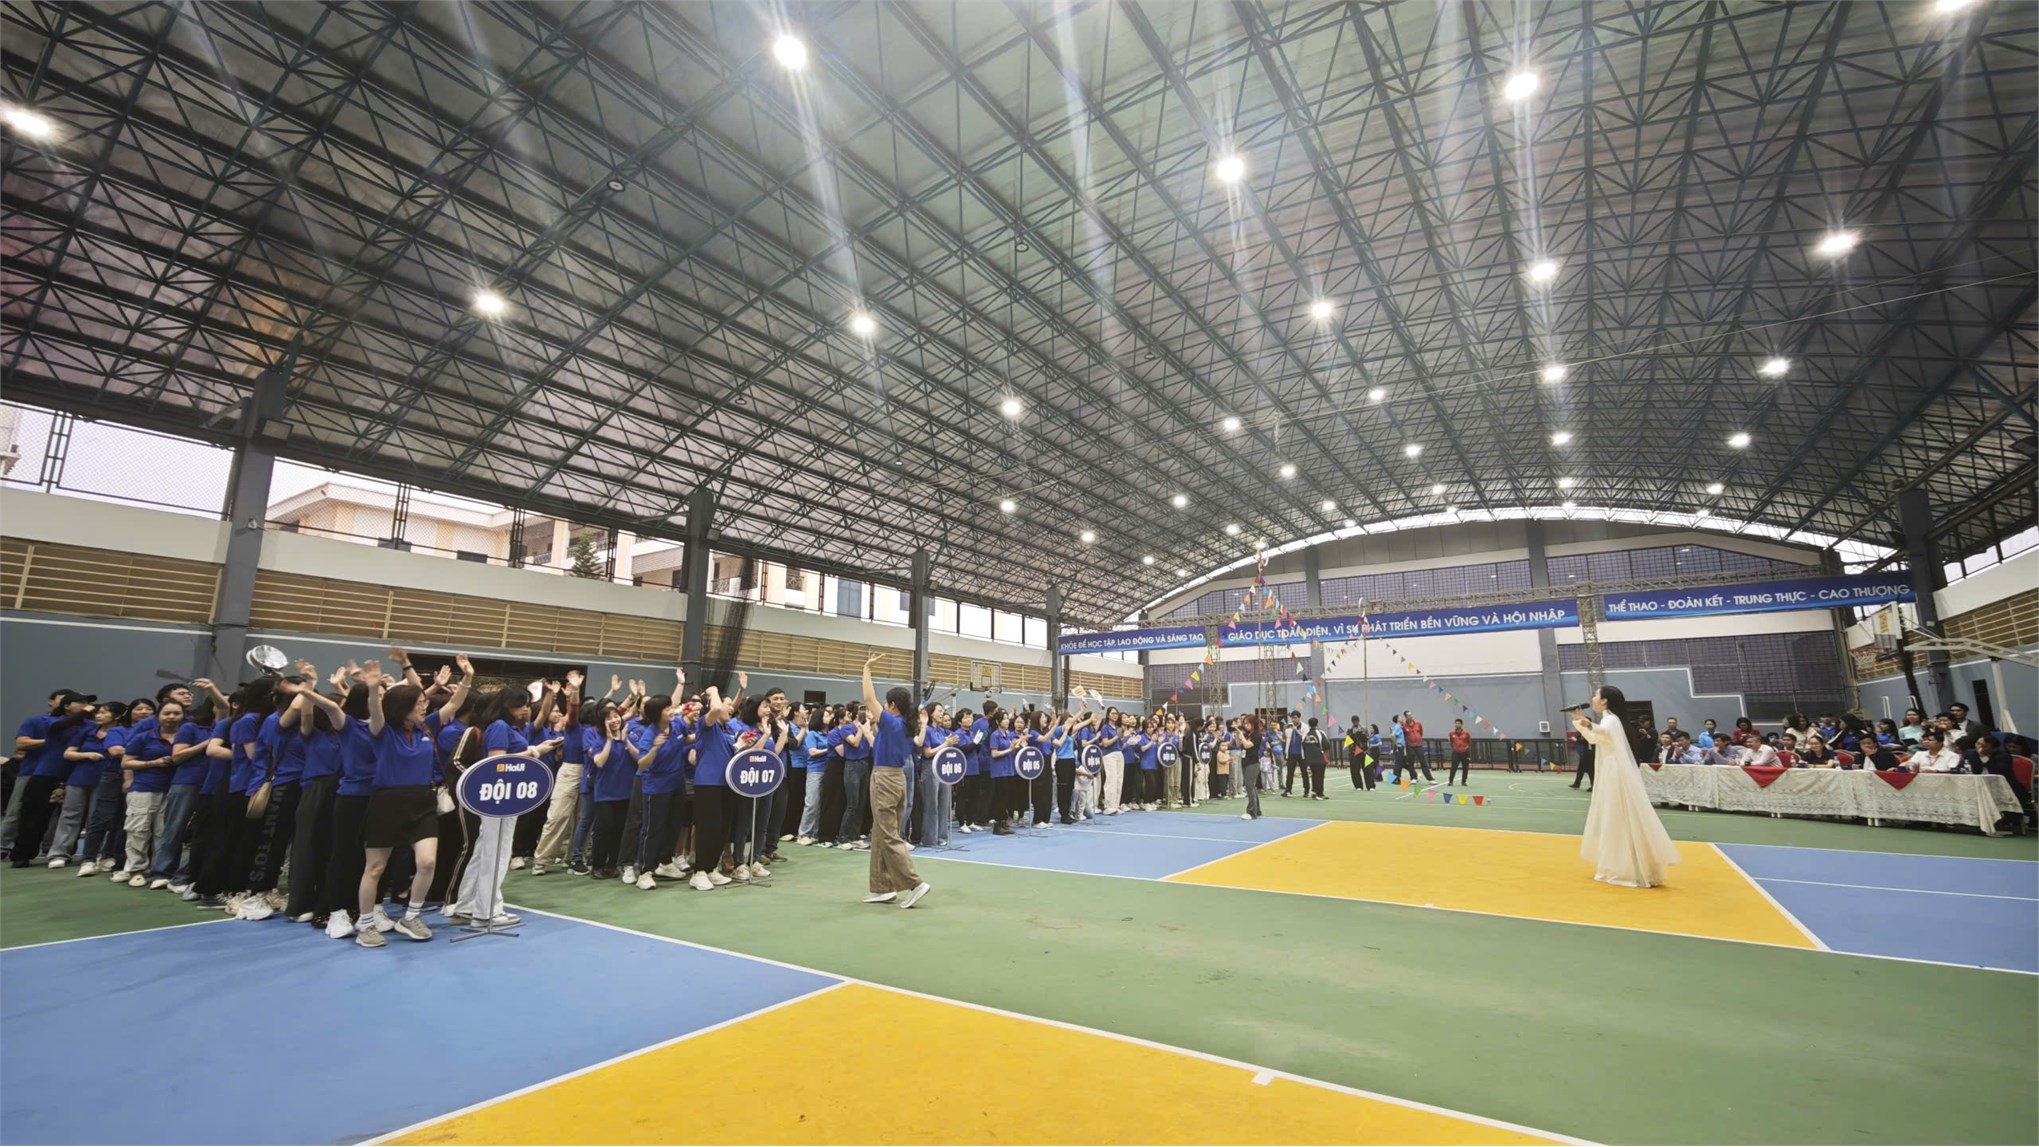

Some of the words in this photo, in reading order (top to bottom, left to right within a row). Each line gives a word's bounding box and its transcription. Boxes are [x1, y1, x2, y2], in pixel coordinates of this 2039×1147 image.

[1608, 599, 1627, 612] THỂ
[1628, 601, 1658, 611] THAO
[1668, 597, 1702, 609] ĐOÀN
[1705, 594, 1723, 606] KẾT
[1733, 593, 1772, 605] TRUNG
[1775, 591, 1807, 604] THỰC
[1818, 588, 1849, 599] CAO
[1853, 584, 1910, 598] THƯỢNG
[1228, 630, 1252, 641] GIÁO
[1306, 624, 1331, 637] DIỆN,
[1333, 623, 1344, 634] VÌ
[1389, 616, 1417, 630] TRIỂN
[1420, 615, 1442, 628] BỀN
[1444, 614, 1479, 627] VỮNG
[1482, 612, 1500, 624] VÀ
[1503, 612, 1526, 625] HỘI
[1529, 610, 1566, 624] NHẬP
[1088, 640, 1102, 648] HỌC
[1118, 638, 1132, 646] LAO
[1155, 634, 1166, 643] VÀ
[505, 763, 526, 772] HaUI
[942, 761, 952, 776] ĐỘI
[954, 762, 962, 774] 06
[1023, 758, 1032, 772] ĐỘI
[1033, 760, 1040, 770] 05
[740, 767, 759, 786] ĐỘI
[762, 770, 775, 783] 07
[479, 778, 512, 804] ĐỘI
[516, 782, 538, 799] 08
